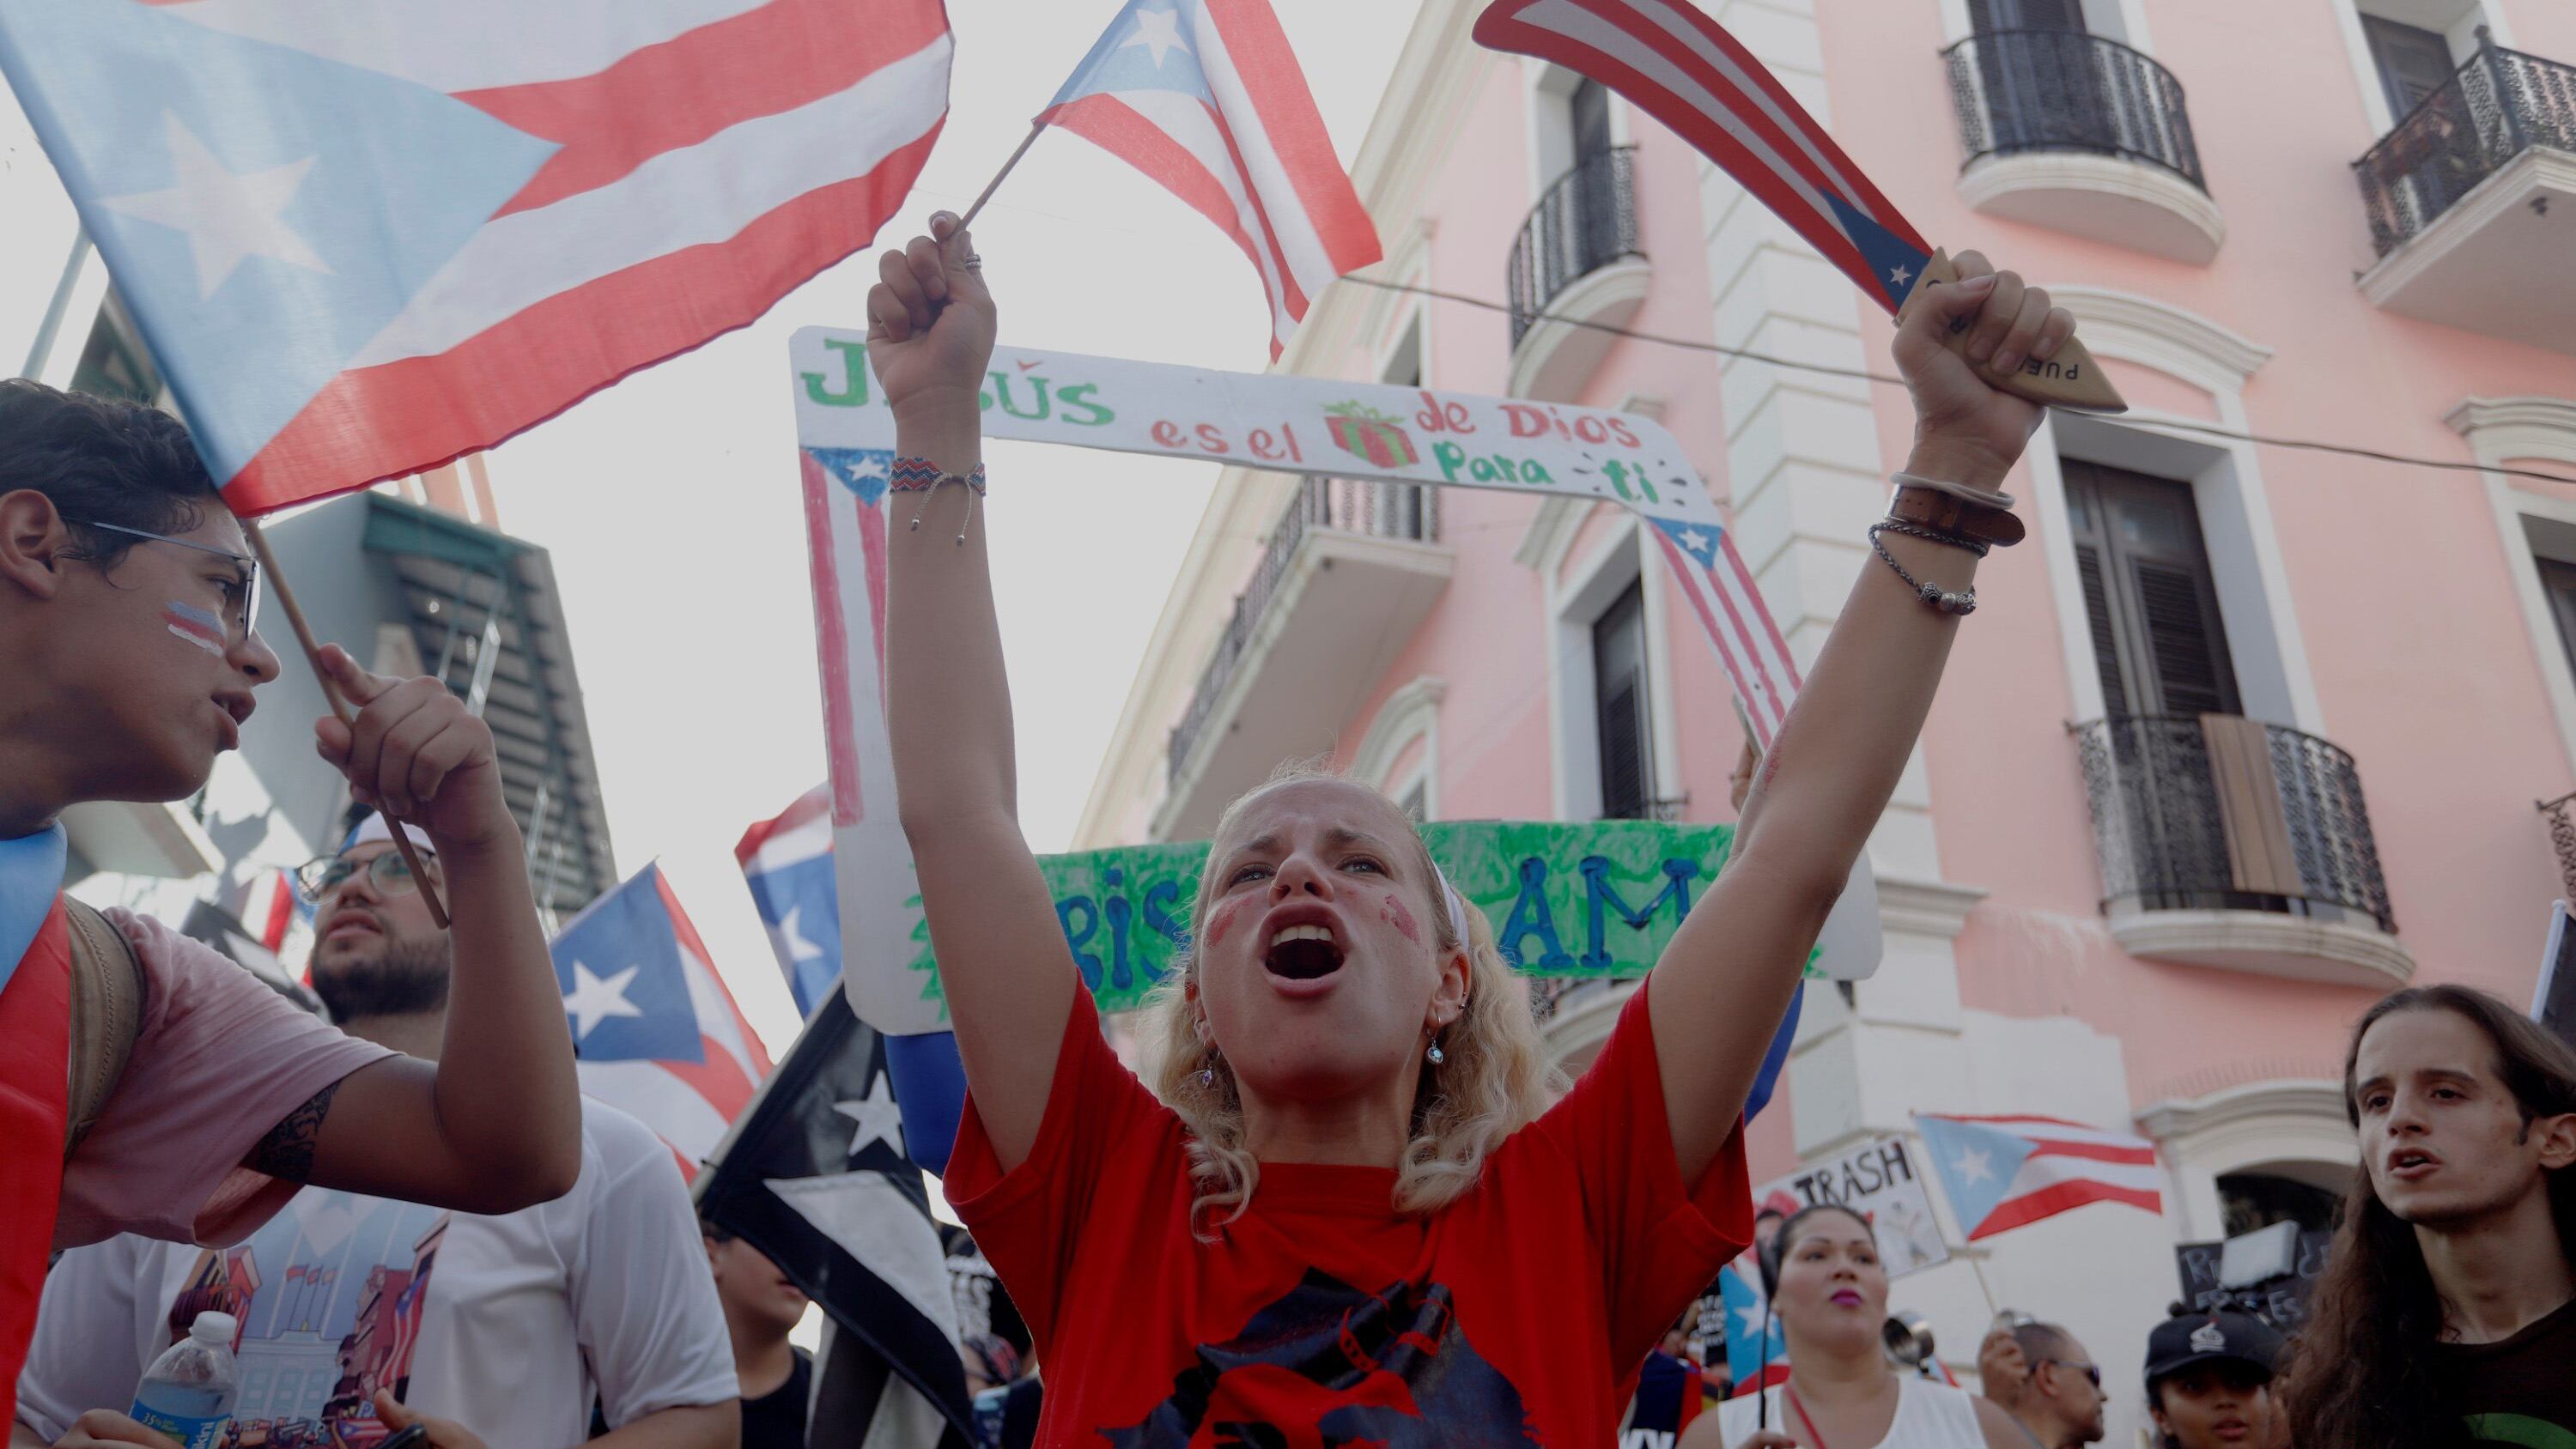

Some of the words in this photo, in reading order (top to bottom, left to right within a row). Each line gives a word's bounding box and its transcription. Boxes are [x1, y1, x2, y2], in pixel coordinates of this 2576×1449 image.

[2019, 355, 2079, 380] PUE
[800, 338, 1115, 427] JÚS
[1151, 420, 1230, 455] es
[1247, 422, 1304, 464] el
[1416, 391, 1476, 436] de
[1602, 458, 1661, 506] ti
[1499, 855, 1700, 970] AM
[1795, 1141, 1912, 1206] TRASH
